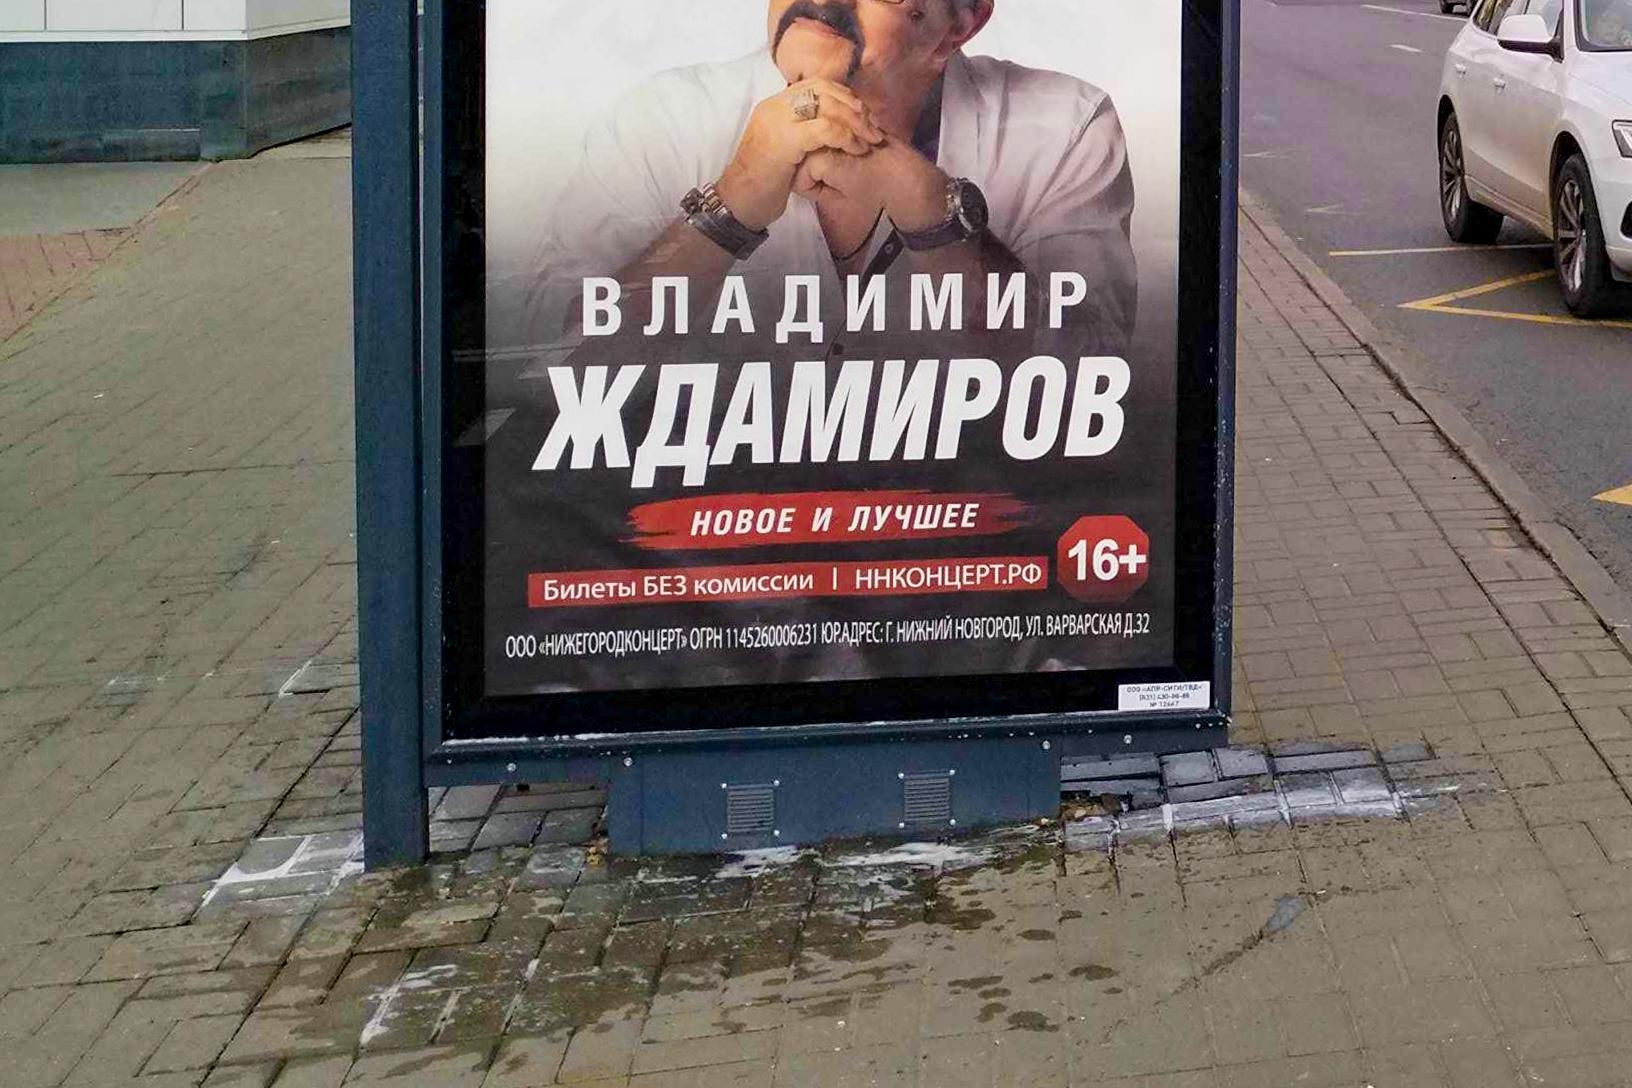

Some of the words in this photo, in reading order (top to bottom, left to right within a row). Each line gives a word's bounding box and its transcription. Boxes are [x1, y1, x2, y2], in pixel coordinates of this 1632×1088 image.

[582, 271, 1088, 342] ВЛАДИМИР
[531, 356, 1131, 488] ЖДАМИРОВ
[690, 507, 795, 537] НОВОЕ
[811, 507, 833, 532] И
[848, 502, 980, 532] ЛУЧШЕЕ
[544, 578, 636, 600] Билеты
[643, 575, 687, 596] БЕЗ
[694, 573, 814, 596] комиссии
[855, 562, 1042, 590] ННКОНЦЕРТ.РФ
[1068, 539, 1147, 581] 16+
[505, 635, 536, 657] ООО
[538, 628, 688, 657] «НИЖЕГОРОДКОНЦЕРТ»
[690, 627, 723, 649] ОГРН
[885, 621, 894, 642] Г.
[896, 614, 952, 642] НИЖНИЙ
[955, 615, 1023, 641] НОВГОРОД,
[1025, 615, 1044, 637] УЛ.
[1046, 612, 1121, 636] ВАРВАРСКАЯ
[1123, 613, 1150, 638] Д.32
